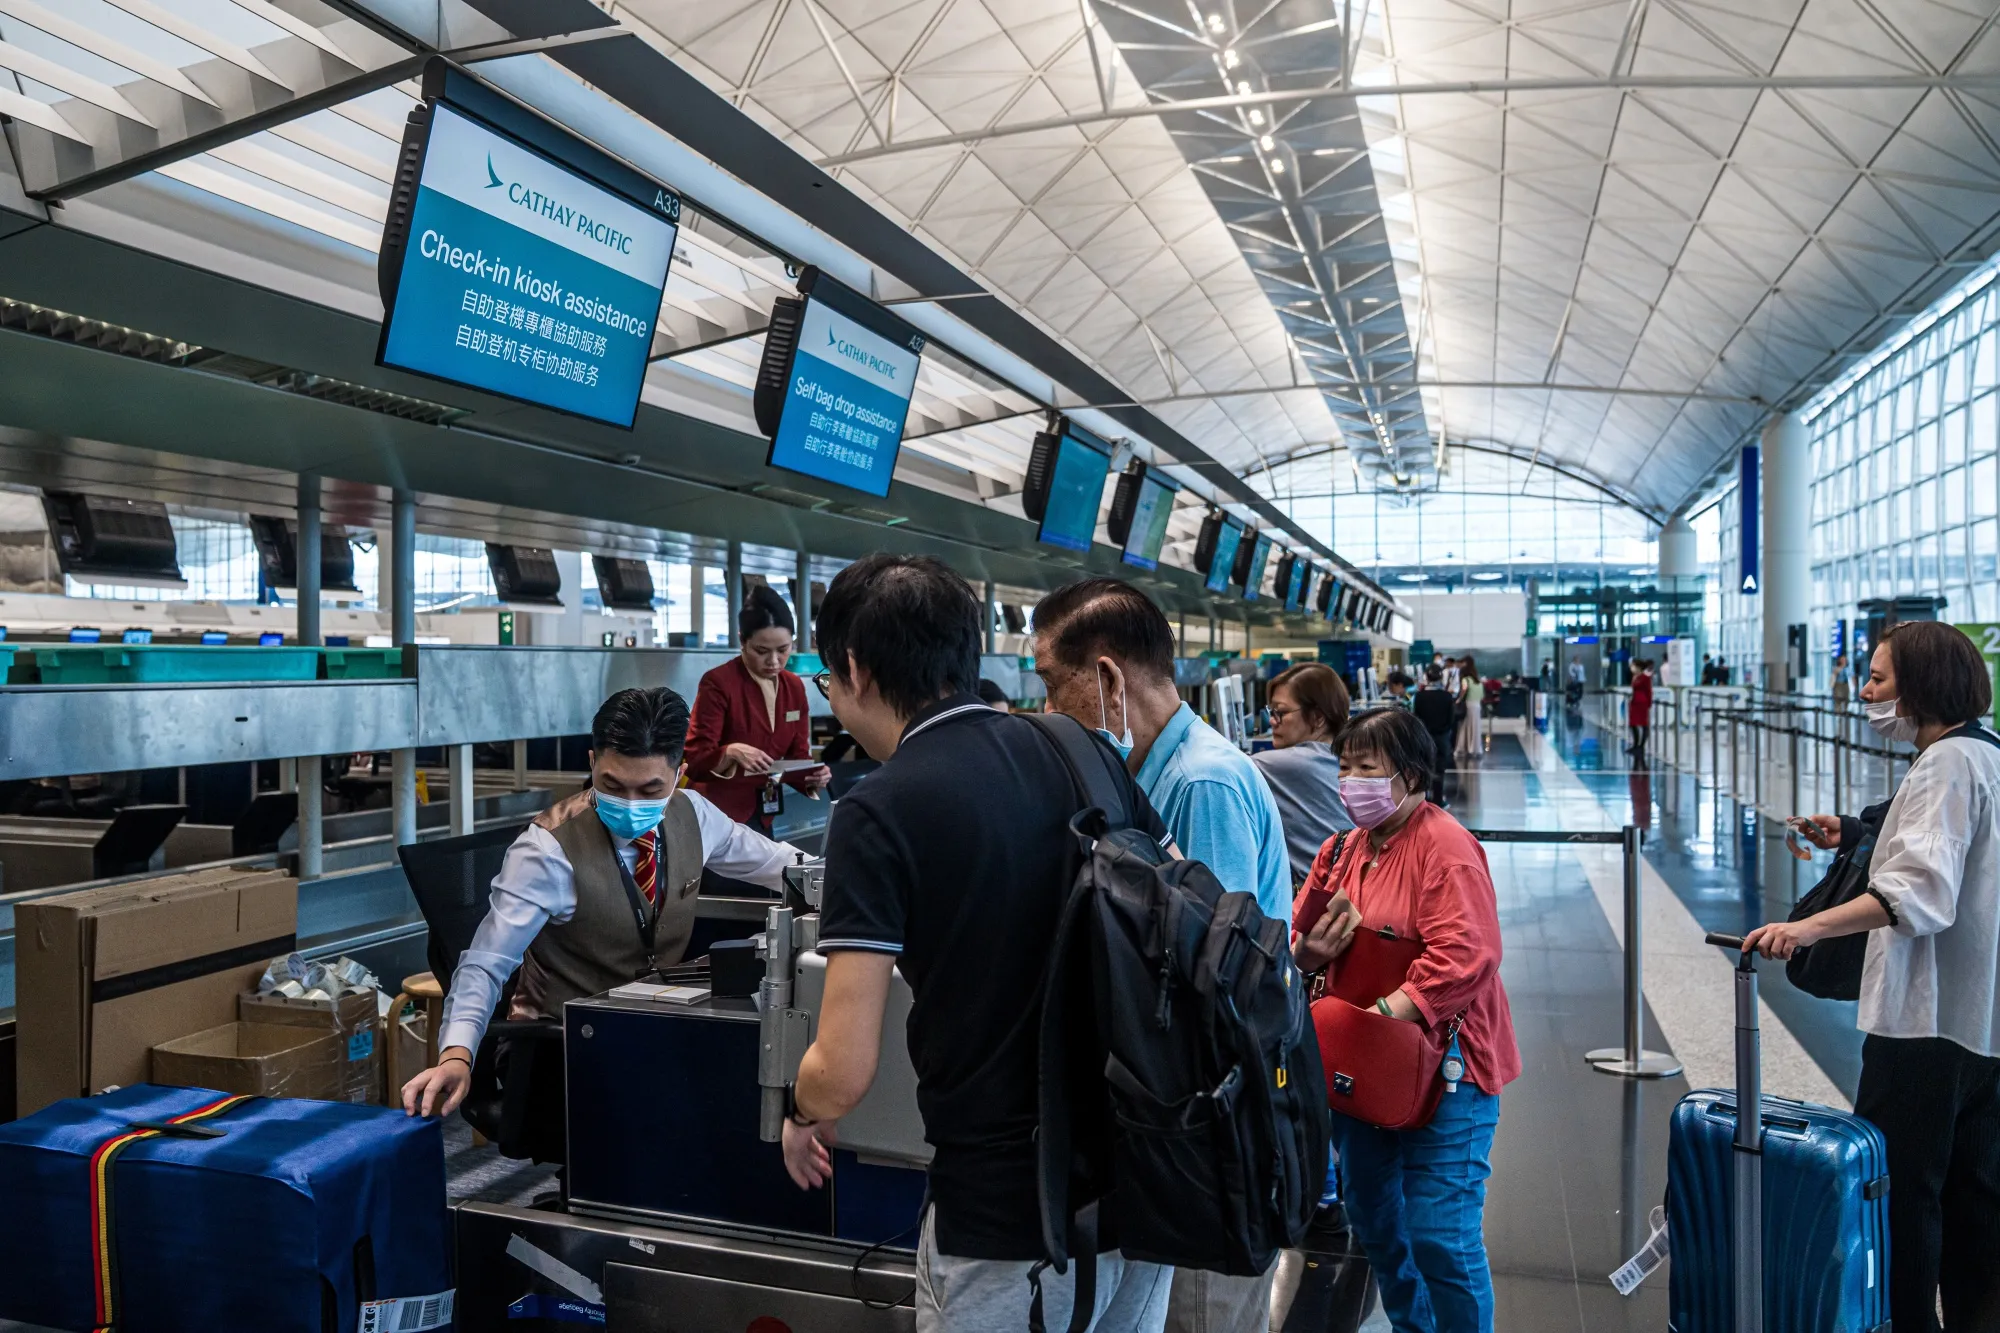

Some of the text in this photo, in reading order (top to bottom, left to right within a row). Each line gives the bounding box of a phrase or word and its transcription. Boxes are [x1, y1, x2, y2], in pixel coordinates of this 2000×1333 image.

[508, 182, 633, 255] CATHAY PACIFIC
[654, 188, 679, 218] A33
[420, 229, 647, 338] Check-in kiosk assistance
[460, 288, 608, 358] 自助登機專櫃協助服務
[908, 335, 925, 351] A32
[455, 324, 599, 387] 自助登机专柜协助服务
[837, 339, 898, 380] CATHAY PACIFIC
[795, 376, 897, 434] Self bag drop assistance
[558, 1302, 584, 1314] Baggage
